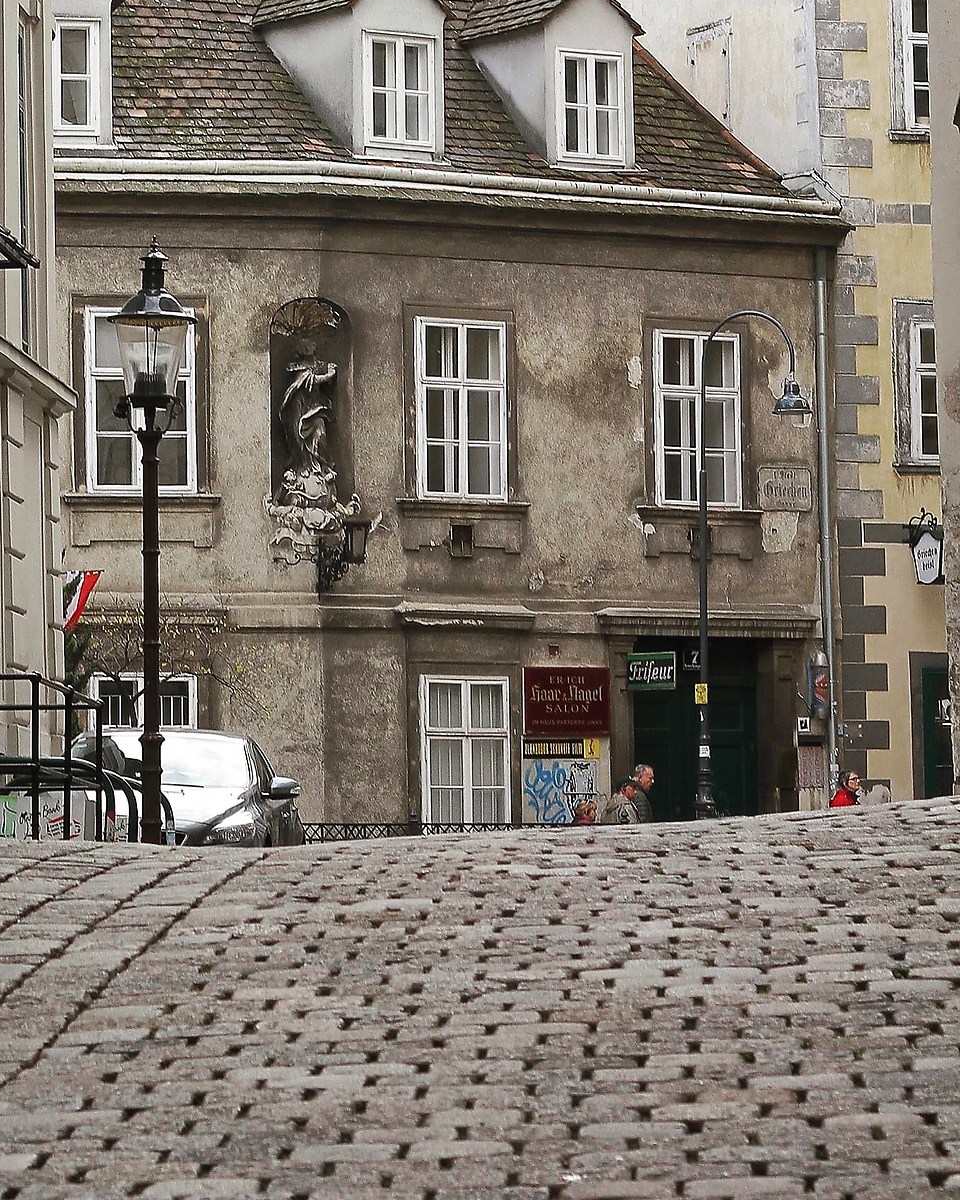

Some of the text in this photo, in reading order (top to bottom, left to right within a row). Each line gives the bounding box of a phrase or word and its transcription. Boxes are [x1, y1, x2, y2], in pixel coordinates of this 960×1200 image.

[691, 651, 699, 664] 7
[549, 676, 585, 684] ERICH
[531, 684, 561, 702] Haar
[568, 685, 602, 704] Nagel
[545, 703, 589, 713] SALON
